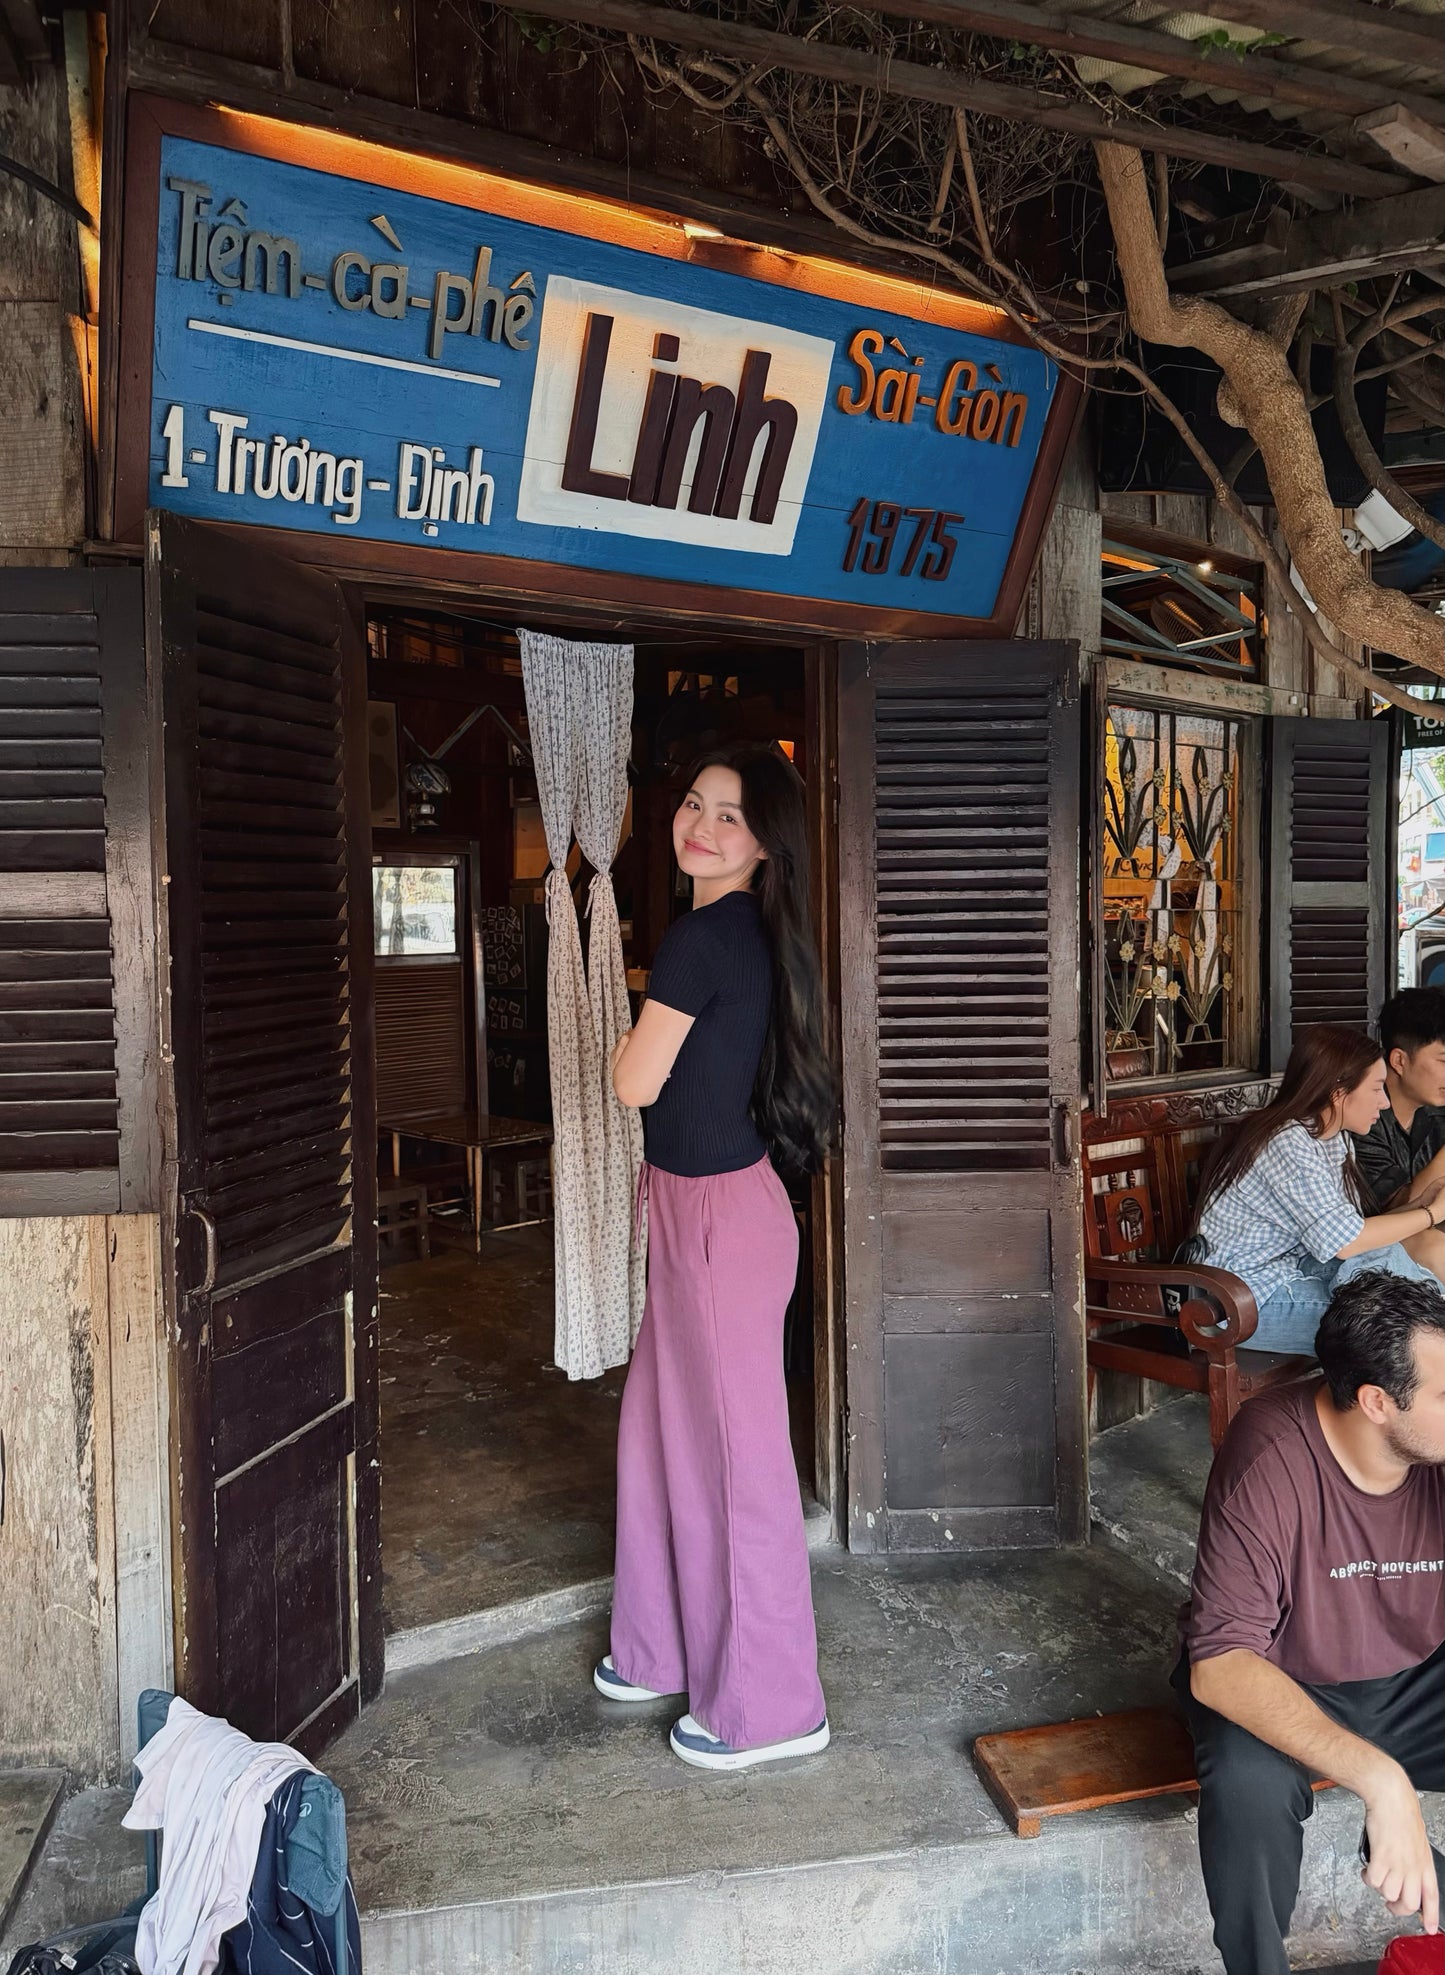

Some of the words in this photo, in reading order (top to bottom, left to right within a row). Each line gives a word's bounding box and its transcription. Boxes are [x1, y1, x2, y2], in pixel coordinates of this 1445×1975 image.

[838, 329, 1029, 448] Sài-Gòn
[561, 312, 798, 525] Linh
[842, 497, 966, 581] 1975
[1413, 716, 1445, 730] TO
[1417, 730, 1434, 738] FREE
[1330, 1560, 1378, 1578] ABSRACT
[1381, 1560, 1444, 1574] MOVEMENT
